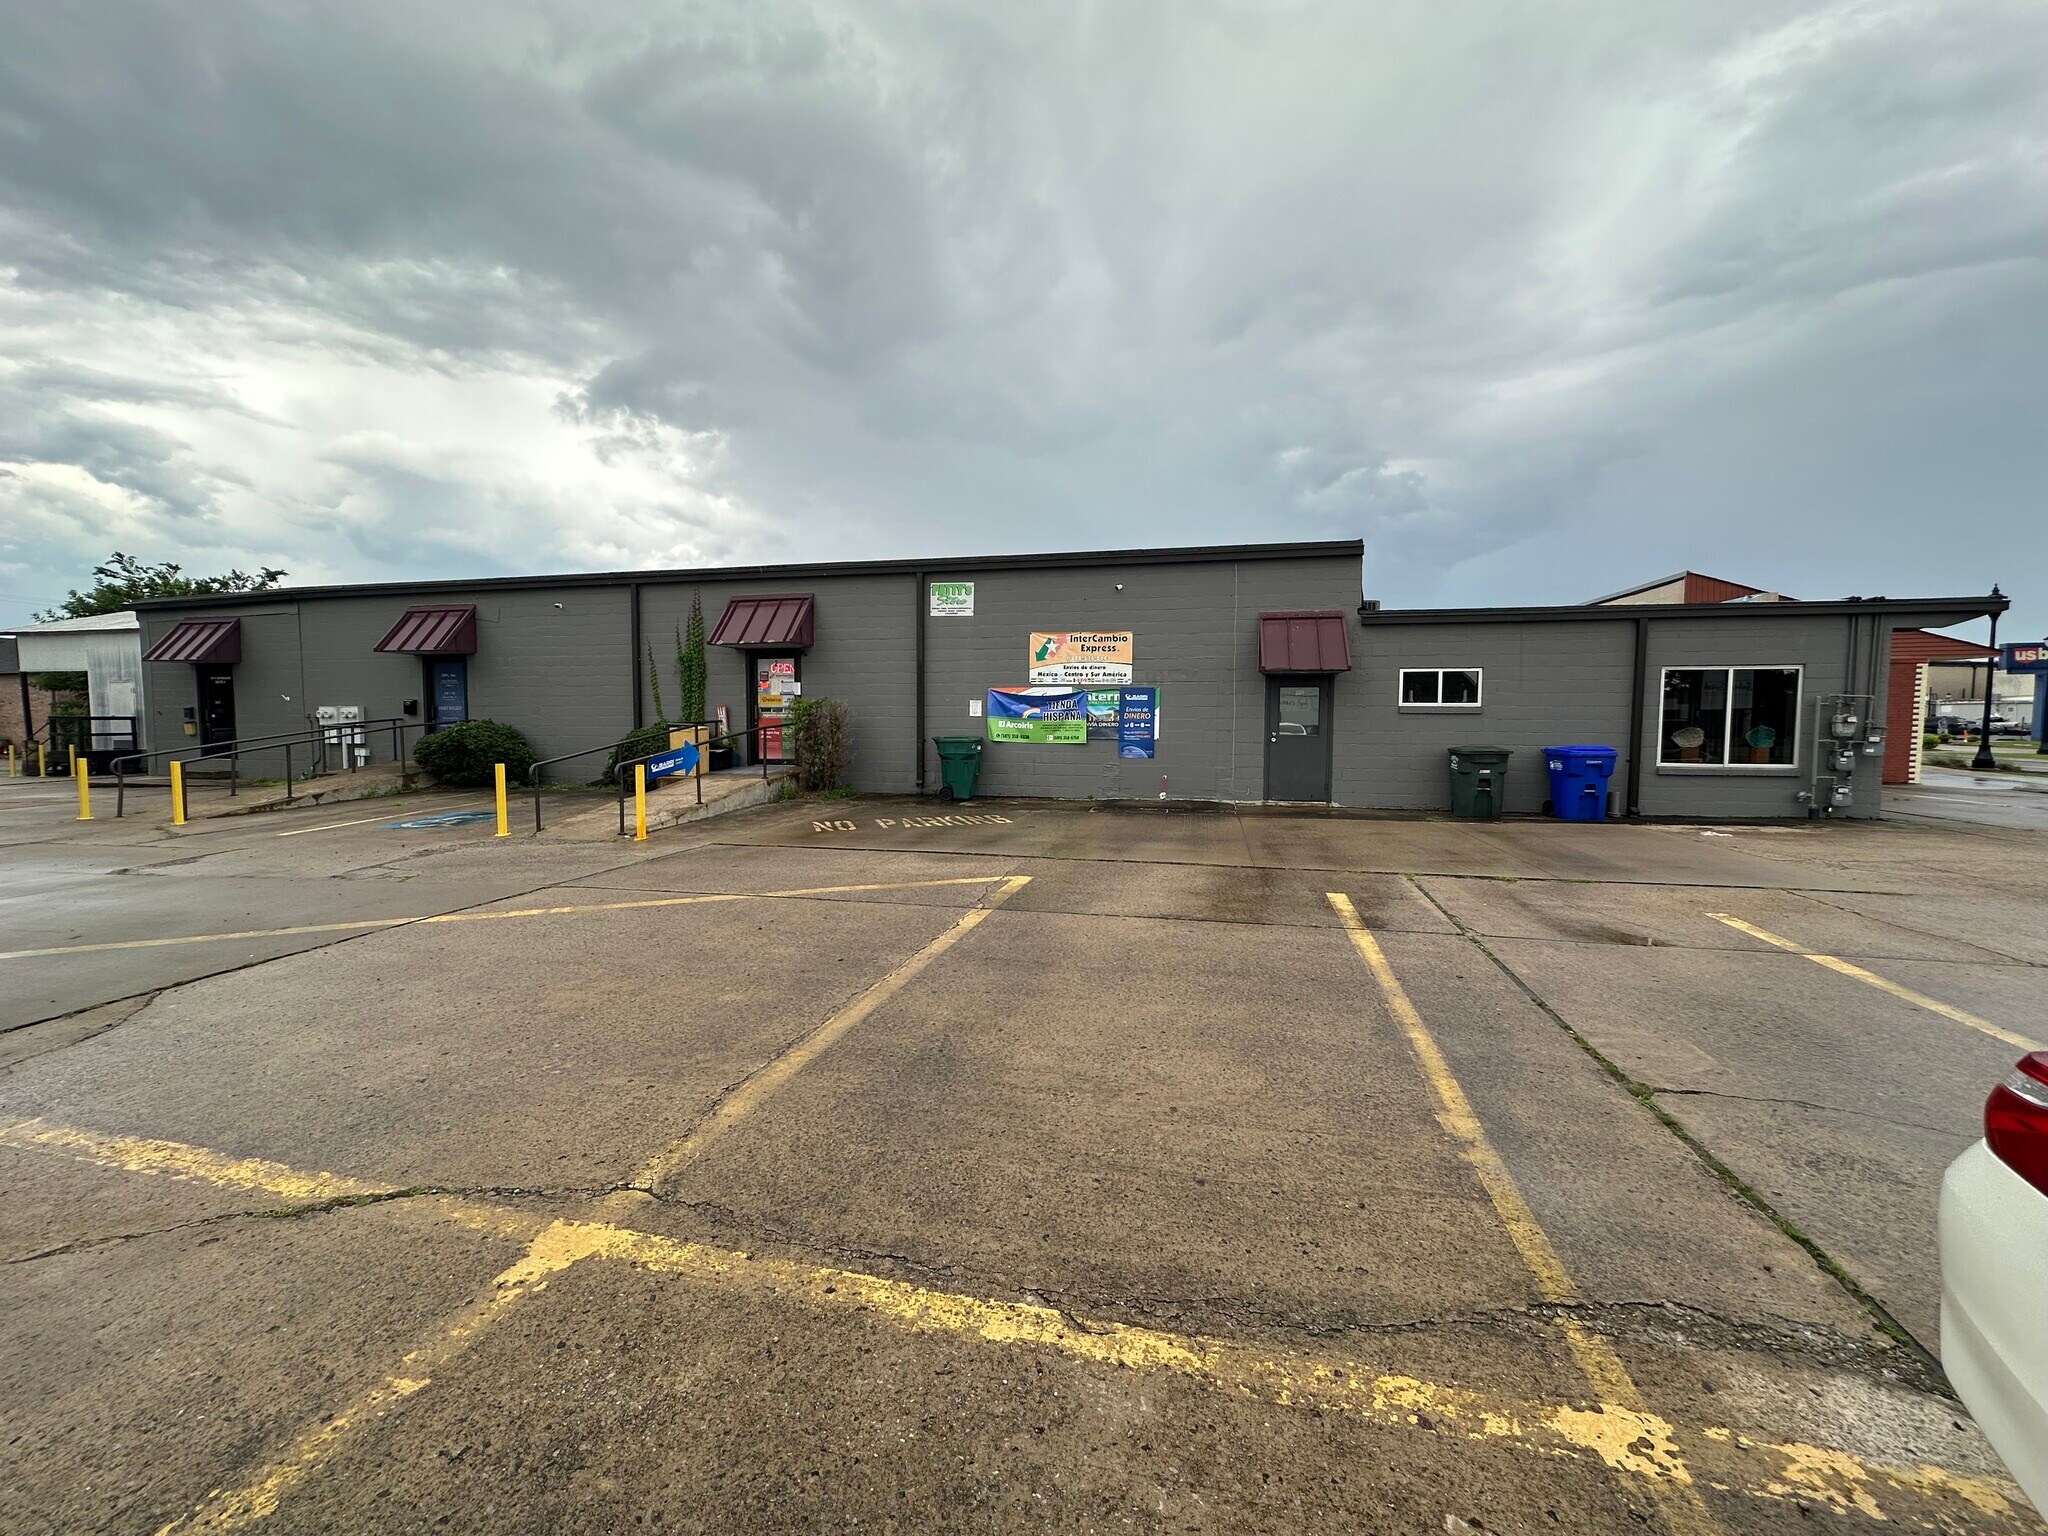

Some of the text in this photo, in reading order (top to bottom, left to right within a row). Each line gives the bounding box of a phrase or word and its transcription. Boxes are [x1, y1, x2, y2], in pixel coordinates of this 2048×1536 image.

[1069, 634, 1128, 643] InterCambio
[1080, 644, 1117, 653] Express
[770, 663, 795, 674] OPEN
[1047, 699, 1078, 710] TIENDA
[1042, 711, 1082, 721] HISPANA
[812, 813, 1014, 832] NO PARKING
